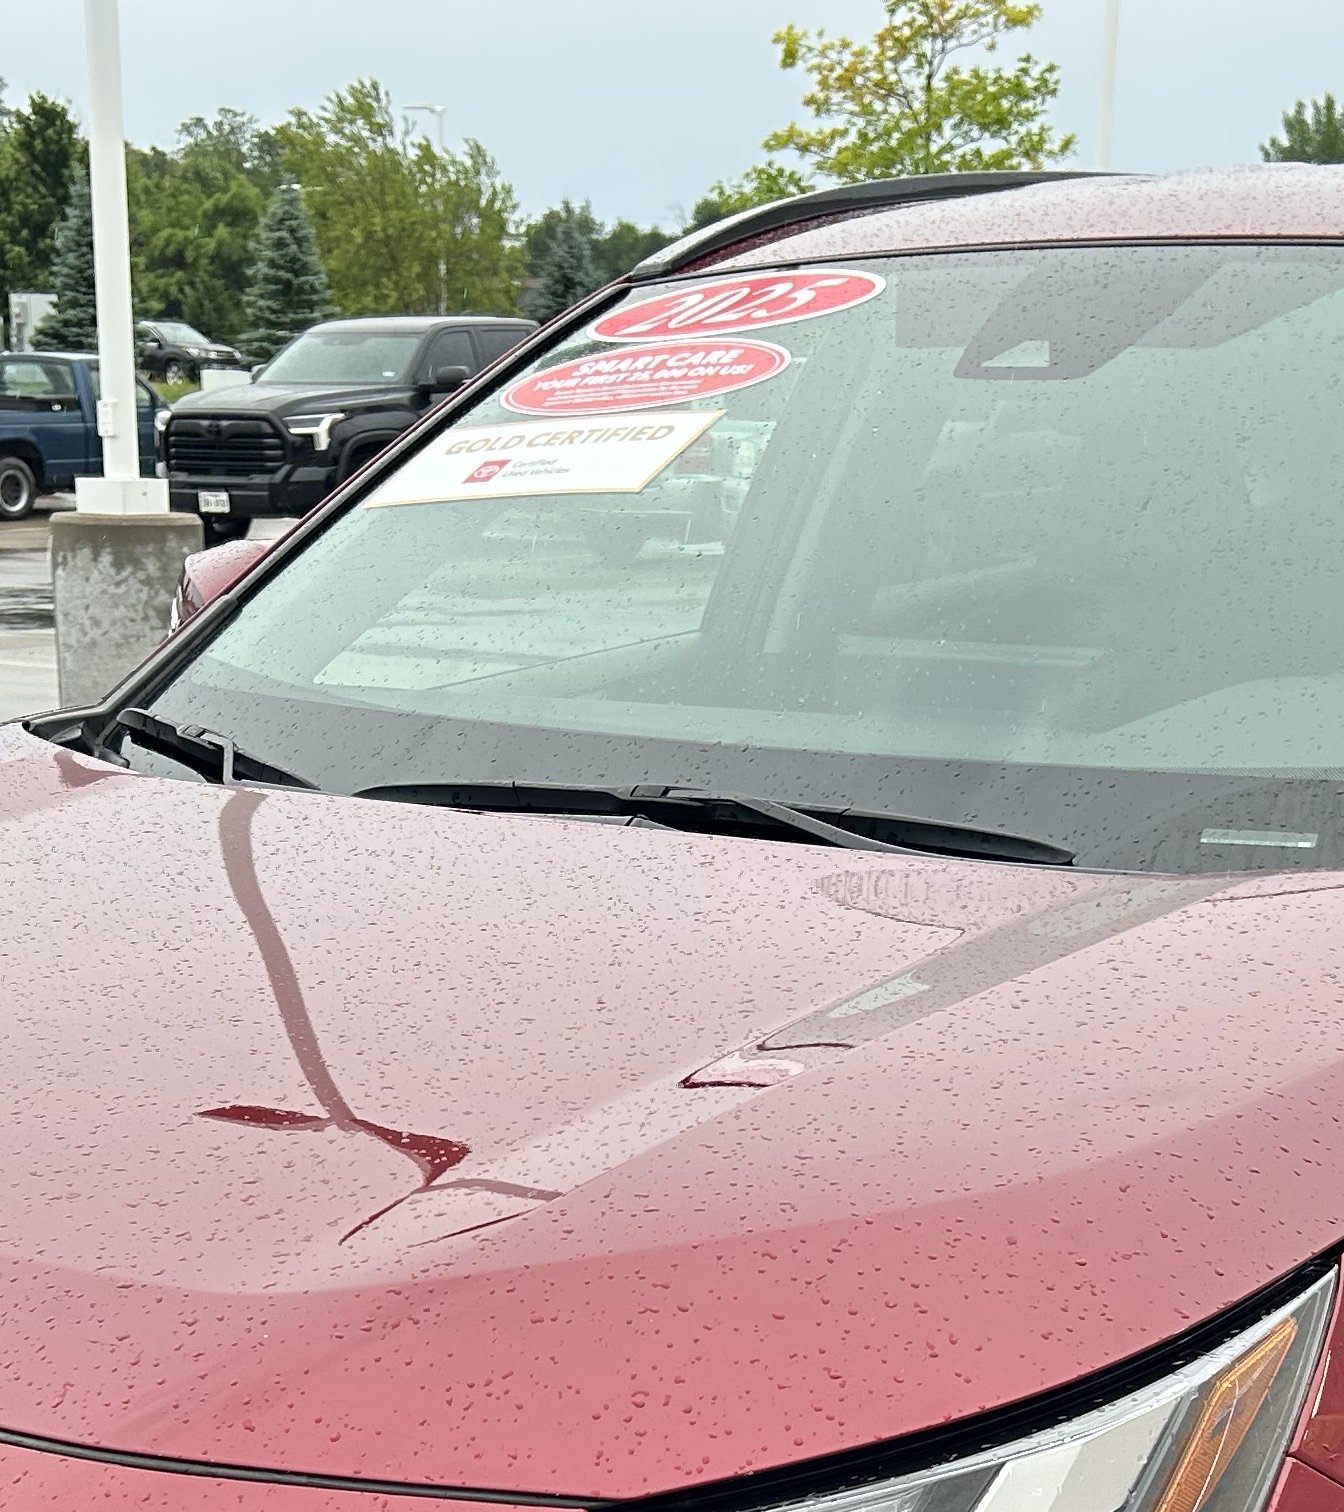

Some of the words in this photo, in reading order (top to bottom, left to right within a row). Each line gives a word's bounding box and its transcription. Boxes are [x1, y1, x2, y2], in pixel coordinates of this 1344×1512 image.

[614, 278, 849, 335] 2025
[571, 354, 670, 377] SMART
[666, 349, 744, 367] CARE
[533, 375, 582, 391] YOUR
[580, 372, 629, 386] FIRST
[687, 365, 720, 377] ON
[445, 435, 526, 455] GOLD
[526, 425, 676, 448] CERTIFIED
